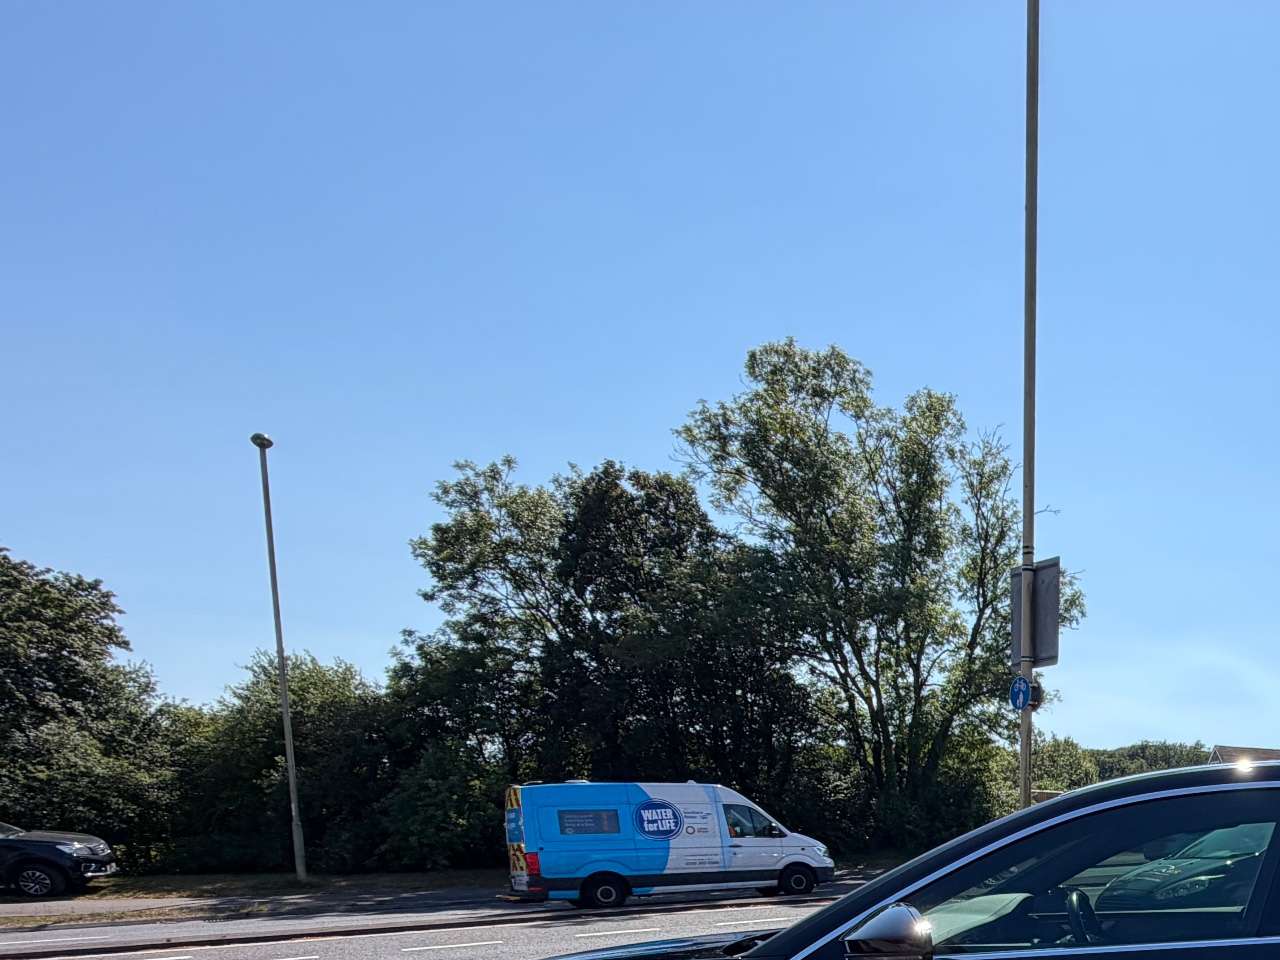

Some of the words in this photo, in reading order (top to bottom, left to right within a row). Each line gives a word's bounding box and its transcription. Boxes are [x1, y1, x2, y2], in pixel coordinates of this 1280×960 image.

[640, 808, 674, 820] WATER
[643, 820, 659, 832] for
[659, 819, 677, 830] LIFE
